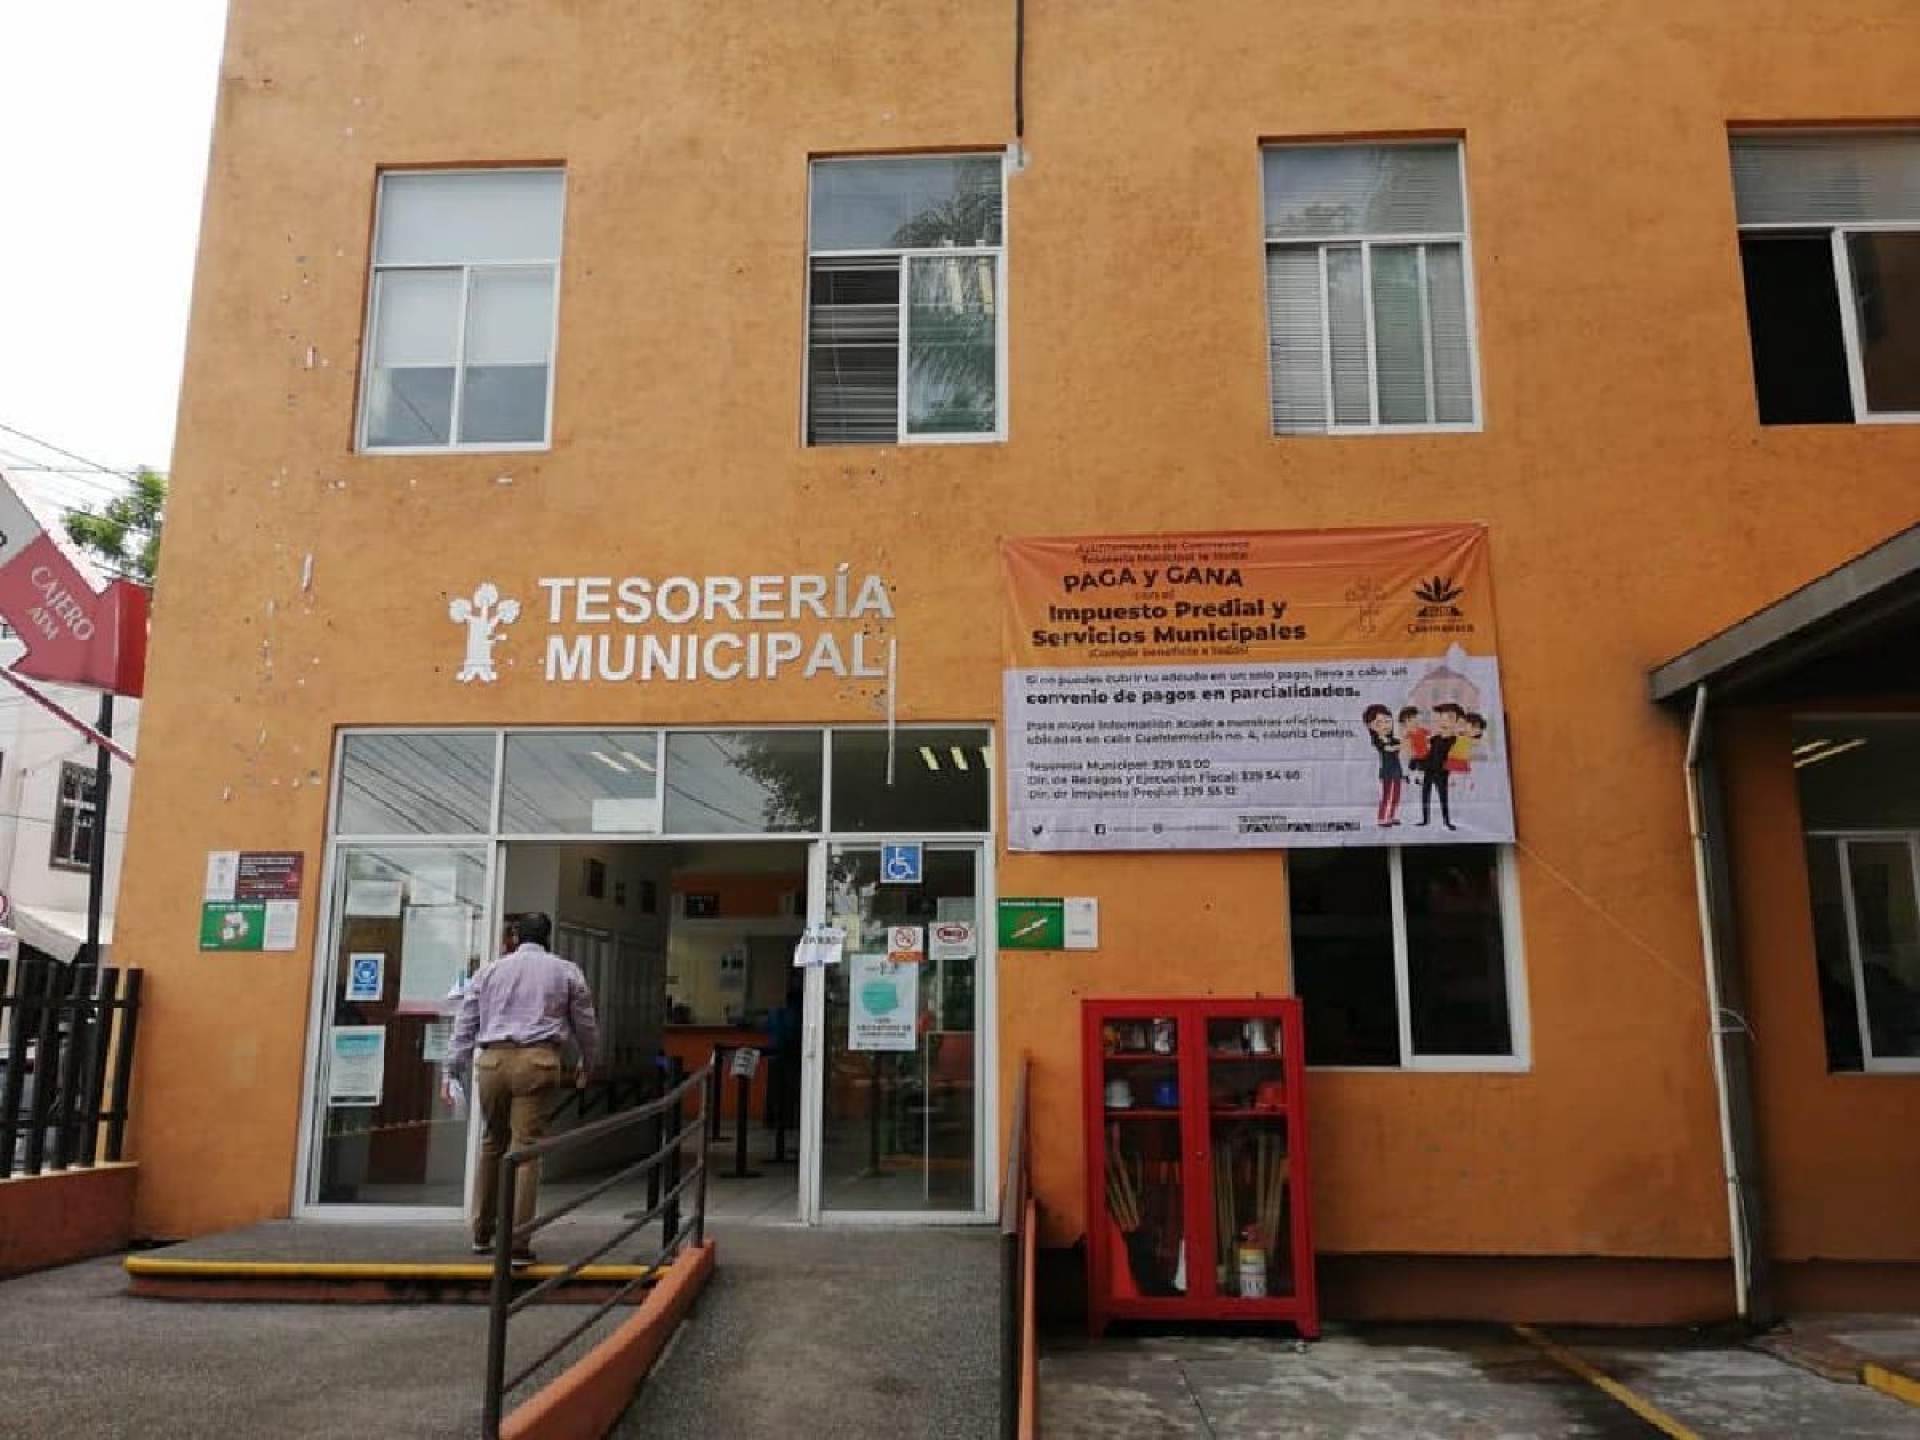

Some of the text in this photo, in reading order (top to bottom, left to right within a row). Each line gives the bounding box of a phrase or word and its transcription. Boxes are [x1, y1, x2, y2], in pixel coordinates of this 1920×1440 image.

[538, 562, 897, 624] TESORERÍA
[1064, 566, 1243, 592] PAGA y GANA
[31, 566, 95, 640] CAJERO
[1050, 599, 1287, 624] Impuesto Predial y
[26, 607, 59, 640] ATM
[1032, 622, 1307, 647] Servicios Municipales
[545, 631, 885, 682] MUNICIPAL
[1026, 683, 1360, 704] convenio de pagos en parcialidades.
